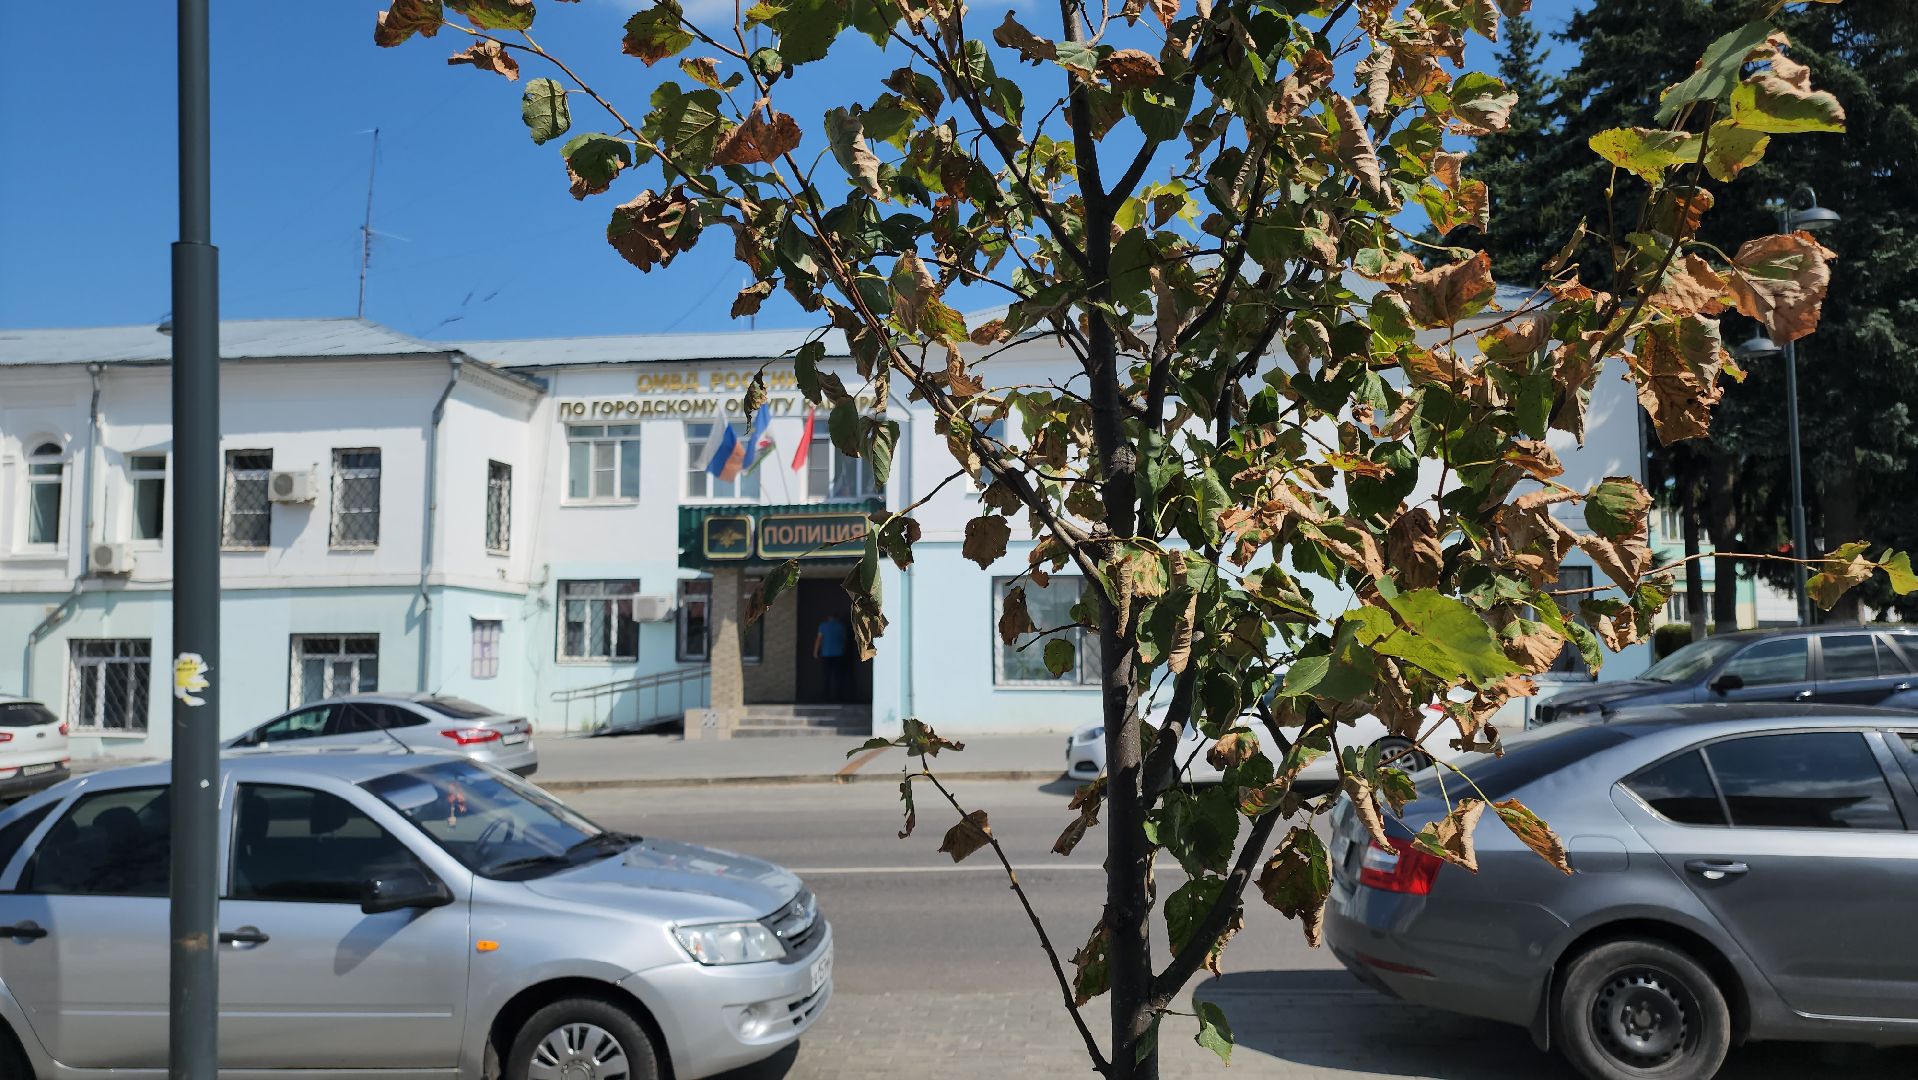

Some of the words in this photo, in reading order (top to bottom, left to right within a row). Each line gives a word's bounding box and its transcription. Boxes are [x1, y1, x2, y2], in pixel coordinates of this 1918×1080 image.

[637, 371, 699, 392] ОМВД
[560, 402, 586, 416] ПО
[592, 399, 718, 416] ГОРОДСКОМУ
[764, 522, 865, 546] ПОЛИЦИЯ
